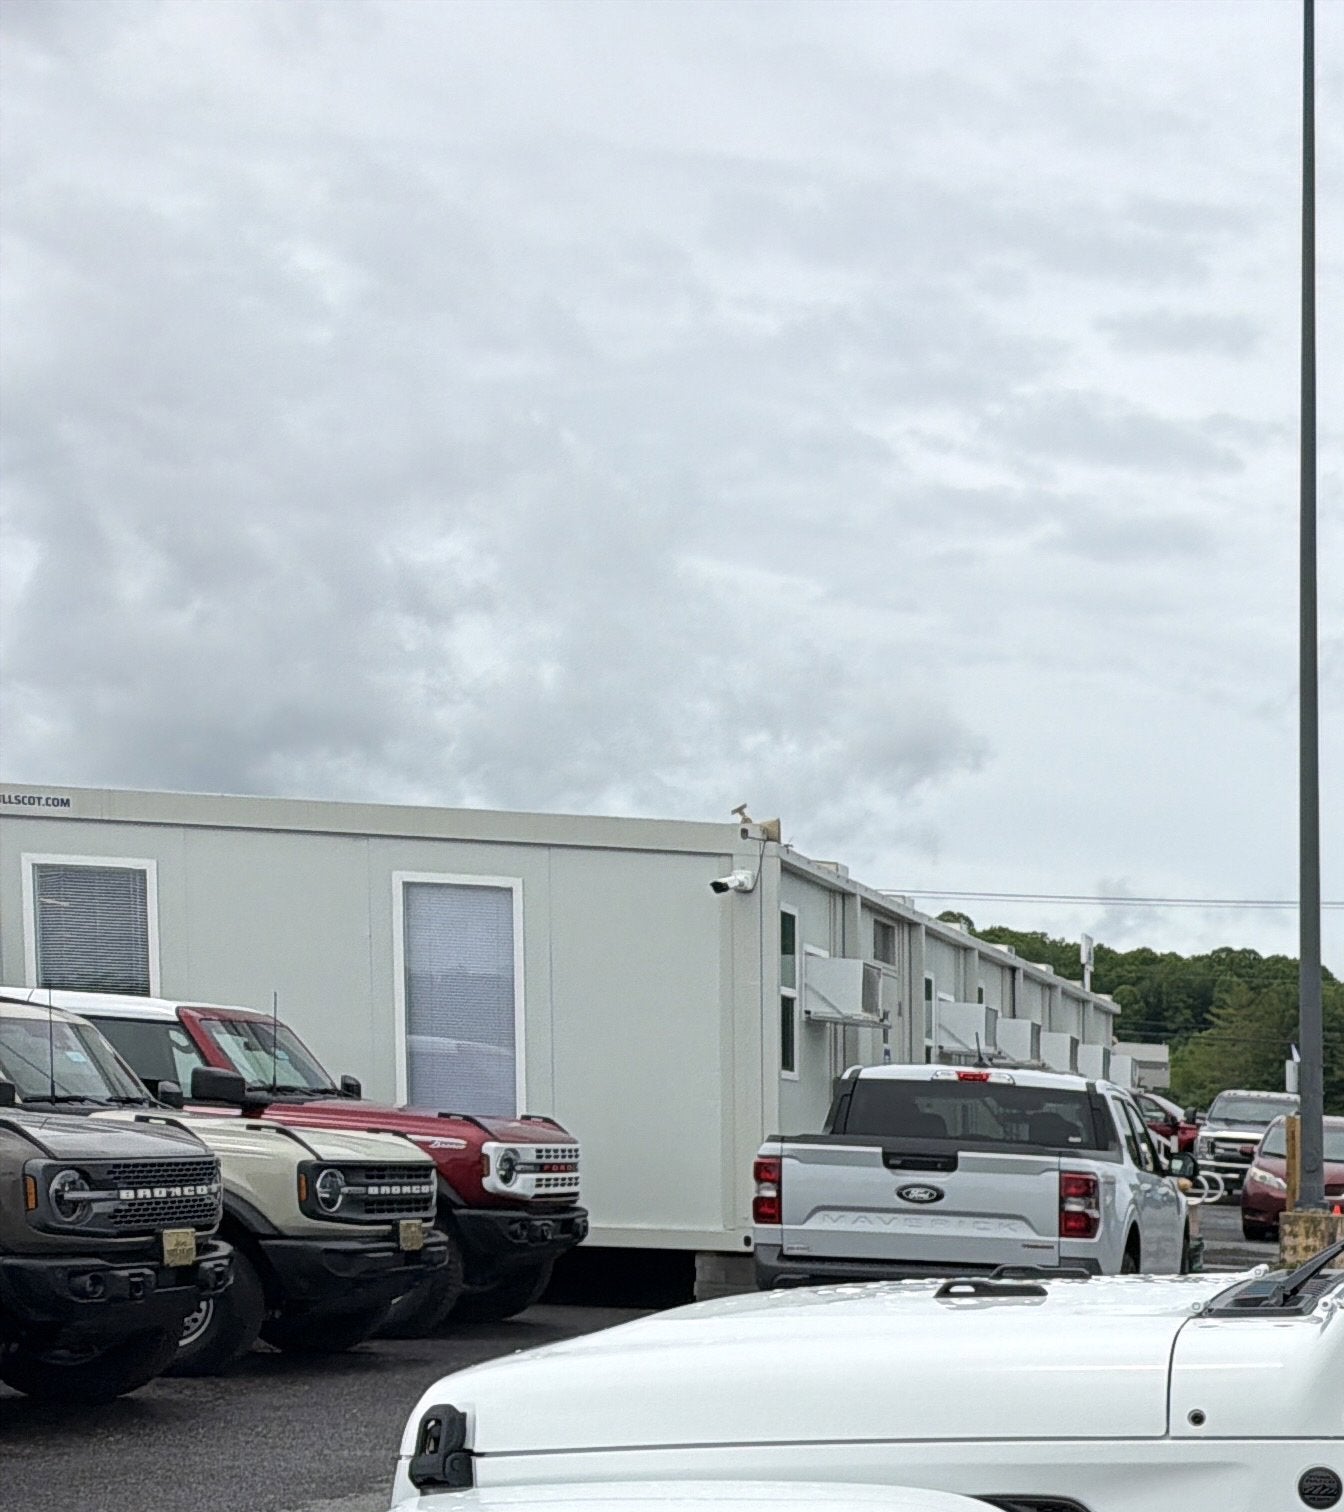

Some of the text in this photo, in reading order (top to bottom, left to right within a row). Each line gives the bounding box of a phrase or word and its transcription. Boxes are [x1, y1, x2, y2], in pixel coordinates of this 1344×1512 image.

[119, 1185, 209, 1201] BRONCO
[367, 1185, 430, 1195] BRONCO
[822, 1214, 1019, 1232] MAVERICK
